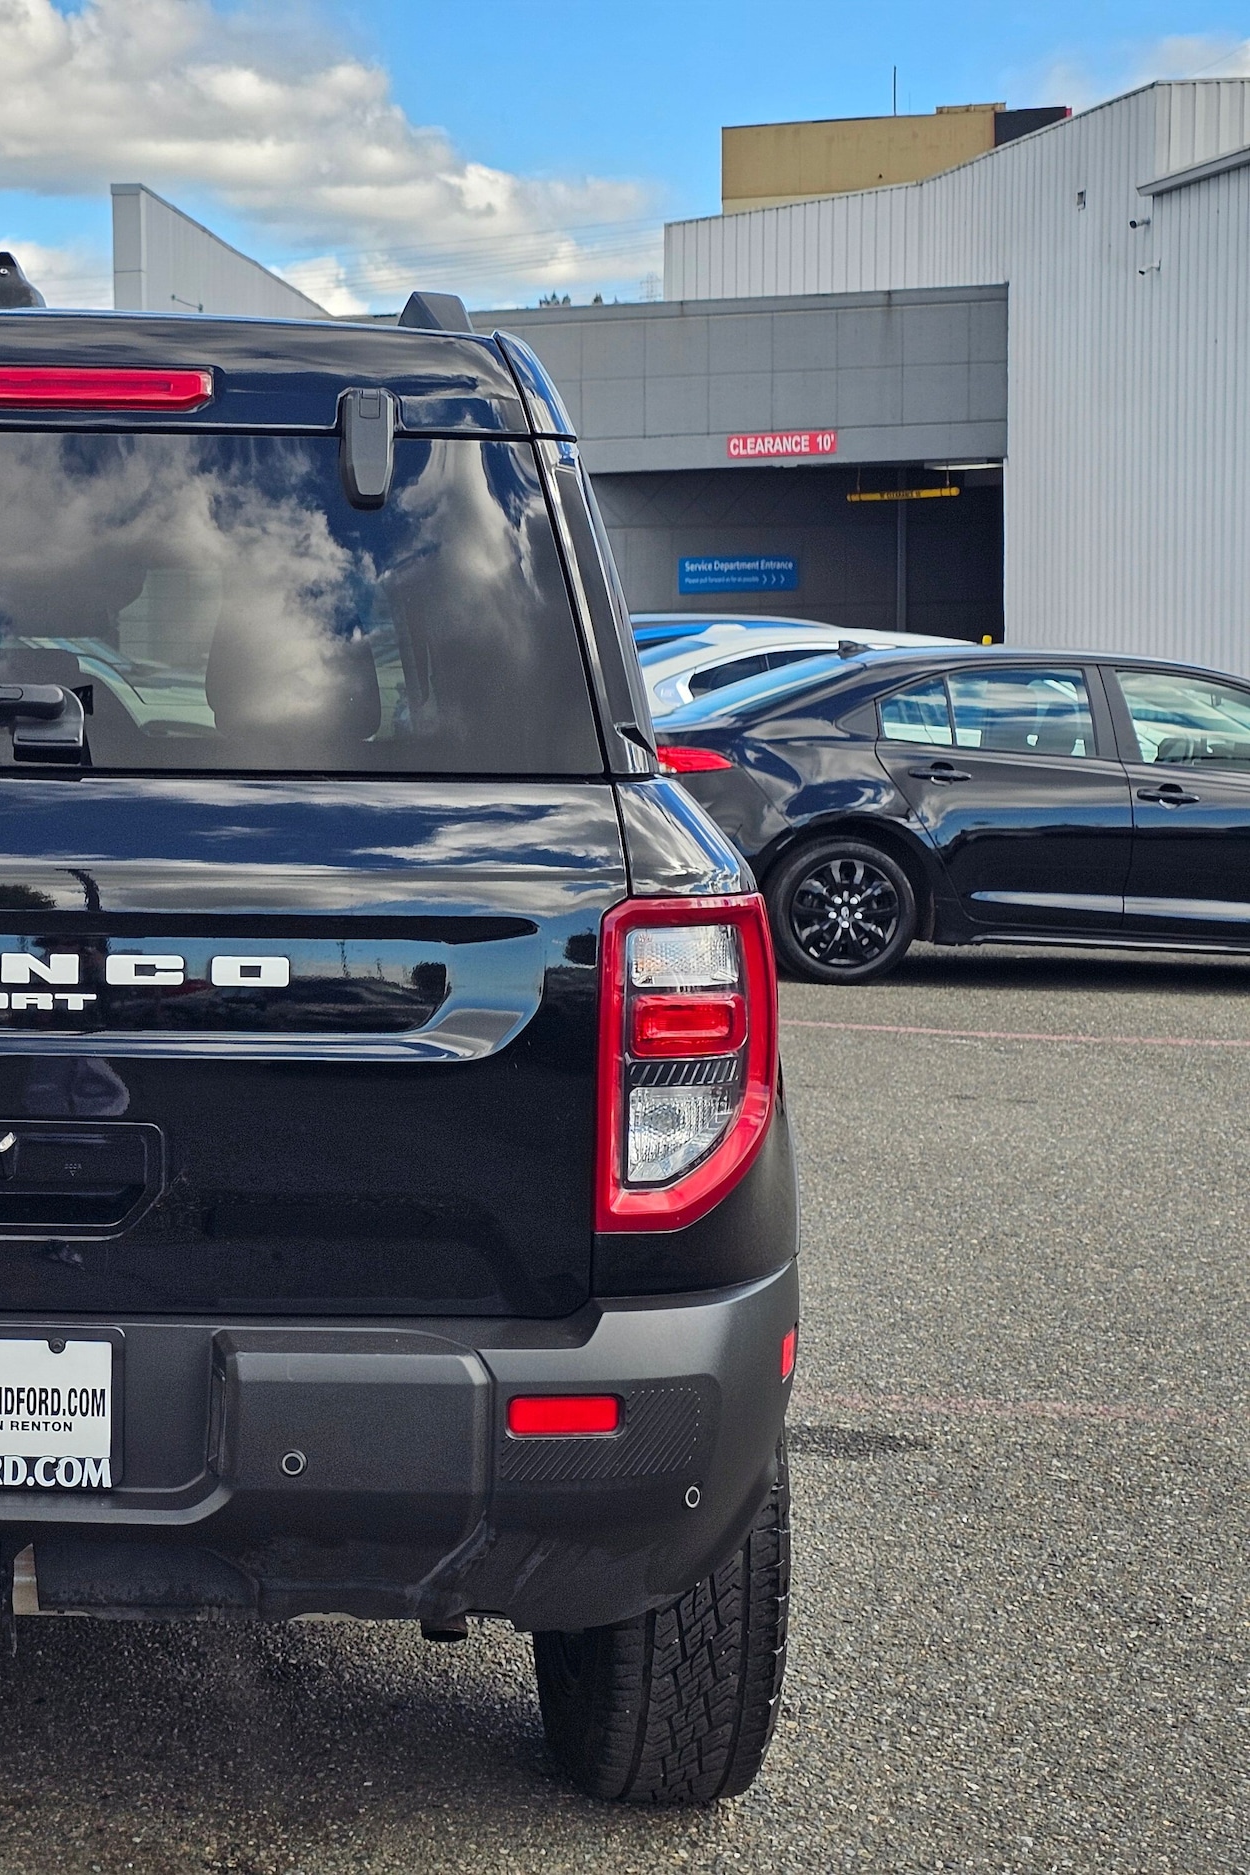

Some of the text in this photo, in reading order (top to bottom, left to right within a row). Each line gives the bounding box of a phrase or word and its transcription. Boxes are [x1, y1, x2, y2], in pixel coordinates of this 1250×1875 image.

[730, 434, 835, 456] CLEARANCE 10'
[685, 559, 793, 573] Service Department Entrance
[10, 1420, 73, 1432] RENTON
